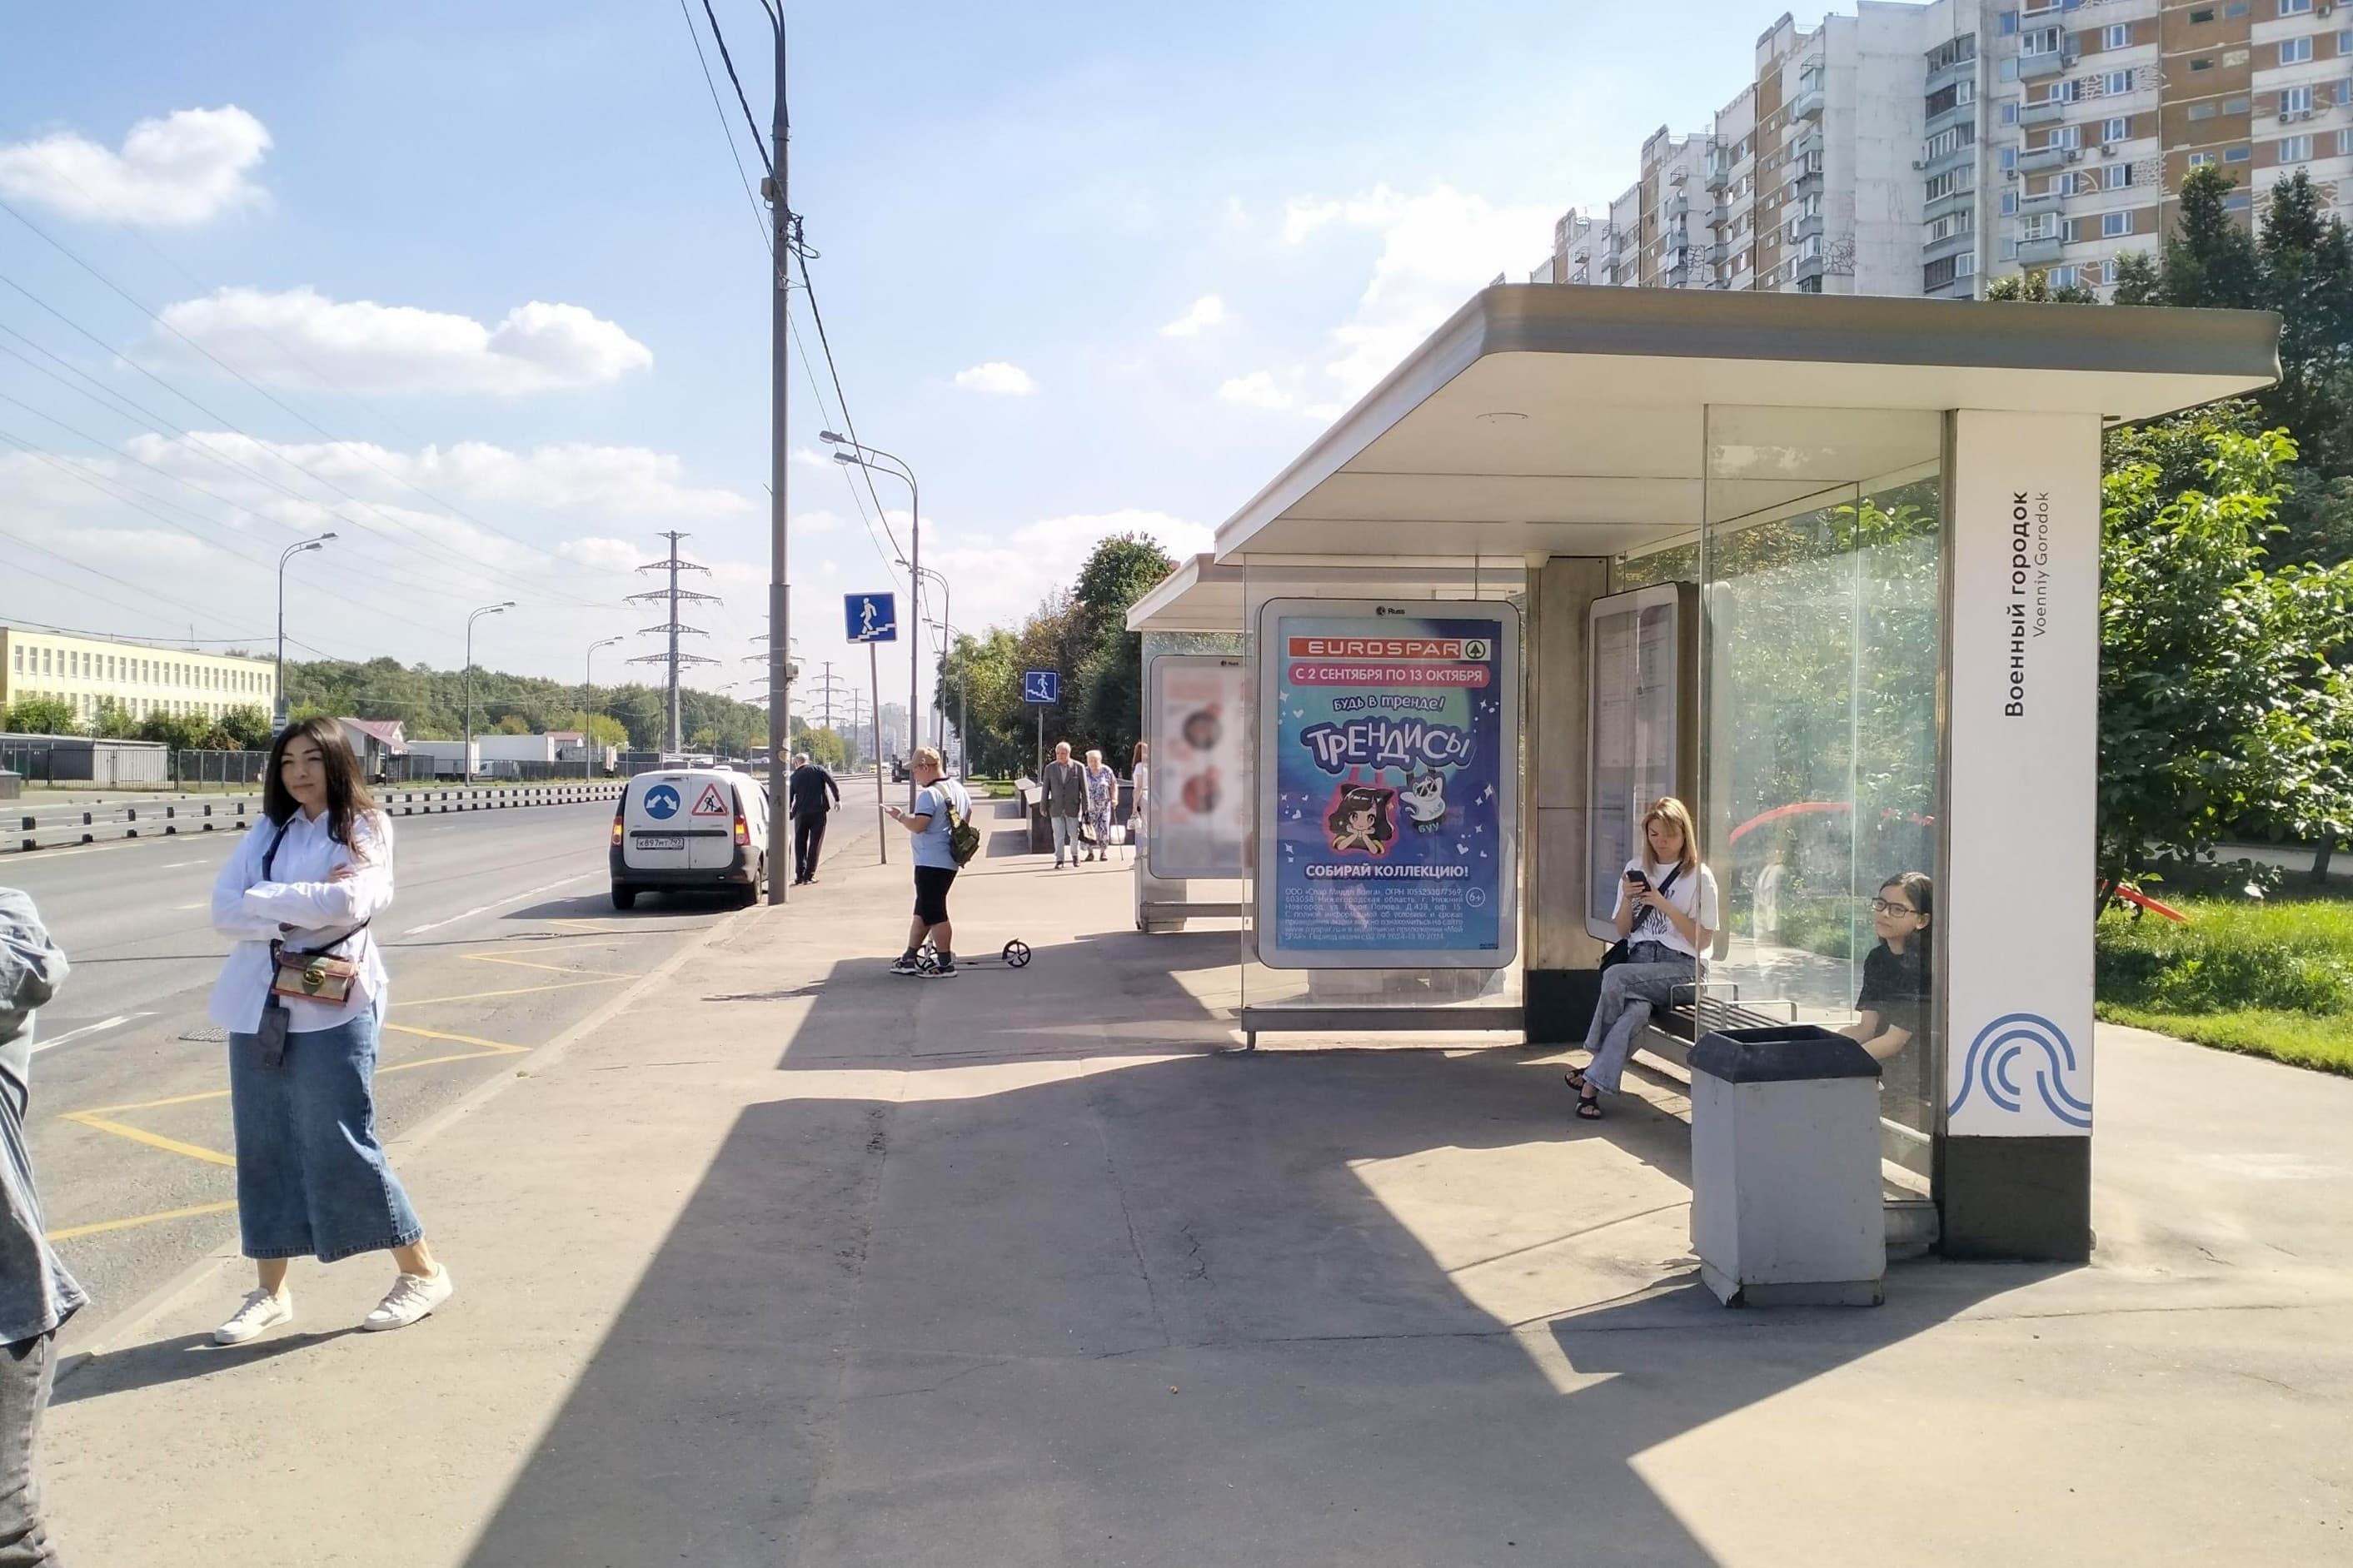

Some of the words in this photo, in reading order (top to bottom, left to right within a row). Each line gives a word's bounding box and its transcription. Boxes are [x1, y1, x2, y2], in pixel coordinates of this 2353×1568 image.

[2034, 491, 2050, 565] Gorodok
[2012, 491, 2031, 595] городок
[2033, 570, 2051, 637] Voenniy
[1308, 640, 1460, 655] EUROSPAR
[2005, 604, 2026, 717] Военный
[1295, 668, 1305, 679] С
[1308, 668, 1316, 679] 2
[1319, 668, 1383, 681] СЕНТЯБРЯ
[1386, 669, 1406, 680] ПО
[1410, 669, 1423, 680] 13
[1426, 669, 1483, 682] ОКТЯБРЯ
[1381, 696, 1445, 710] тренде!
[1307, 722, 1471, 765] ТРЕНДИСЫ
[1305, 863, 1371, 877] СОБИРАЙ
[1374, 865, 1469, 879] КОЛЛЕКЦИЮ!
[1468, 893, 1482, 901] 6+
